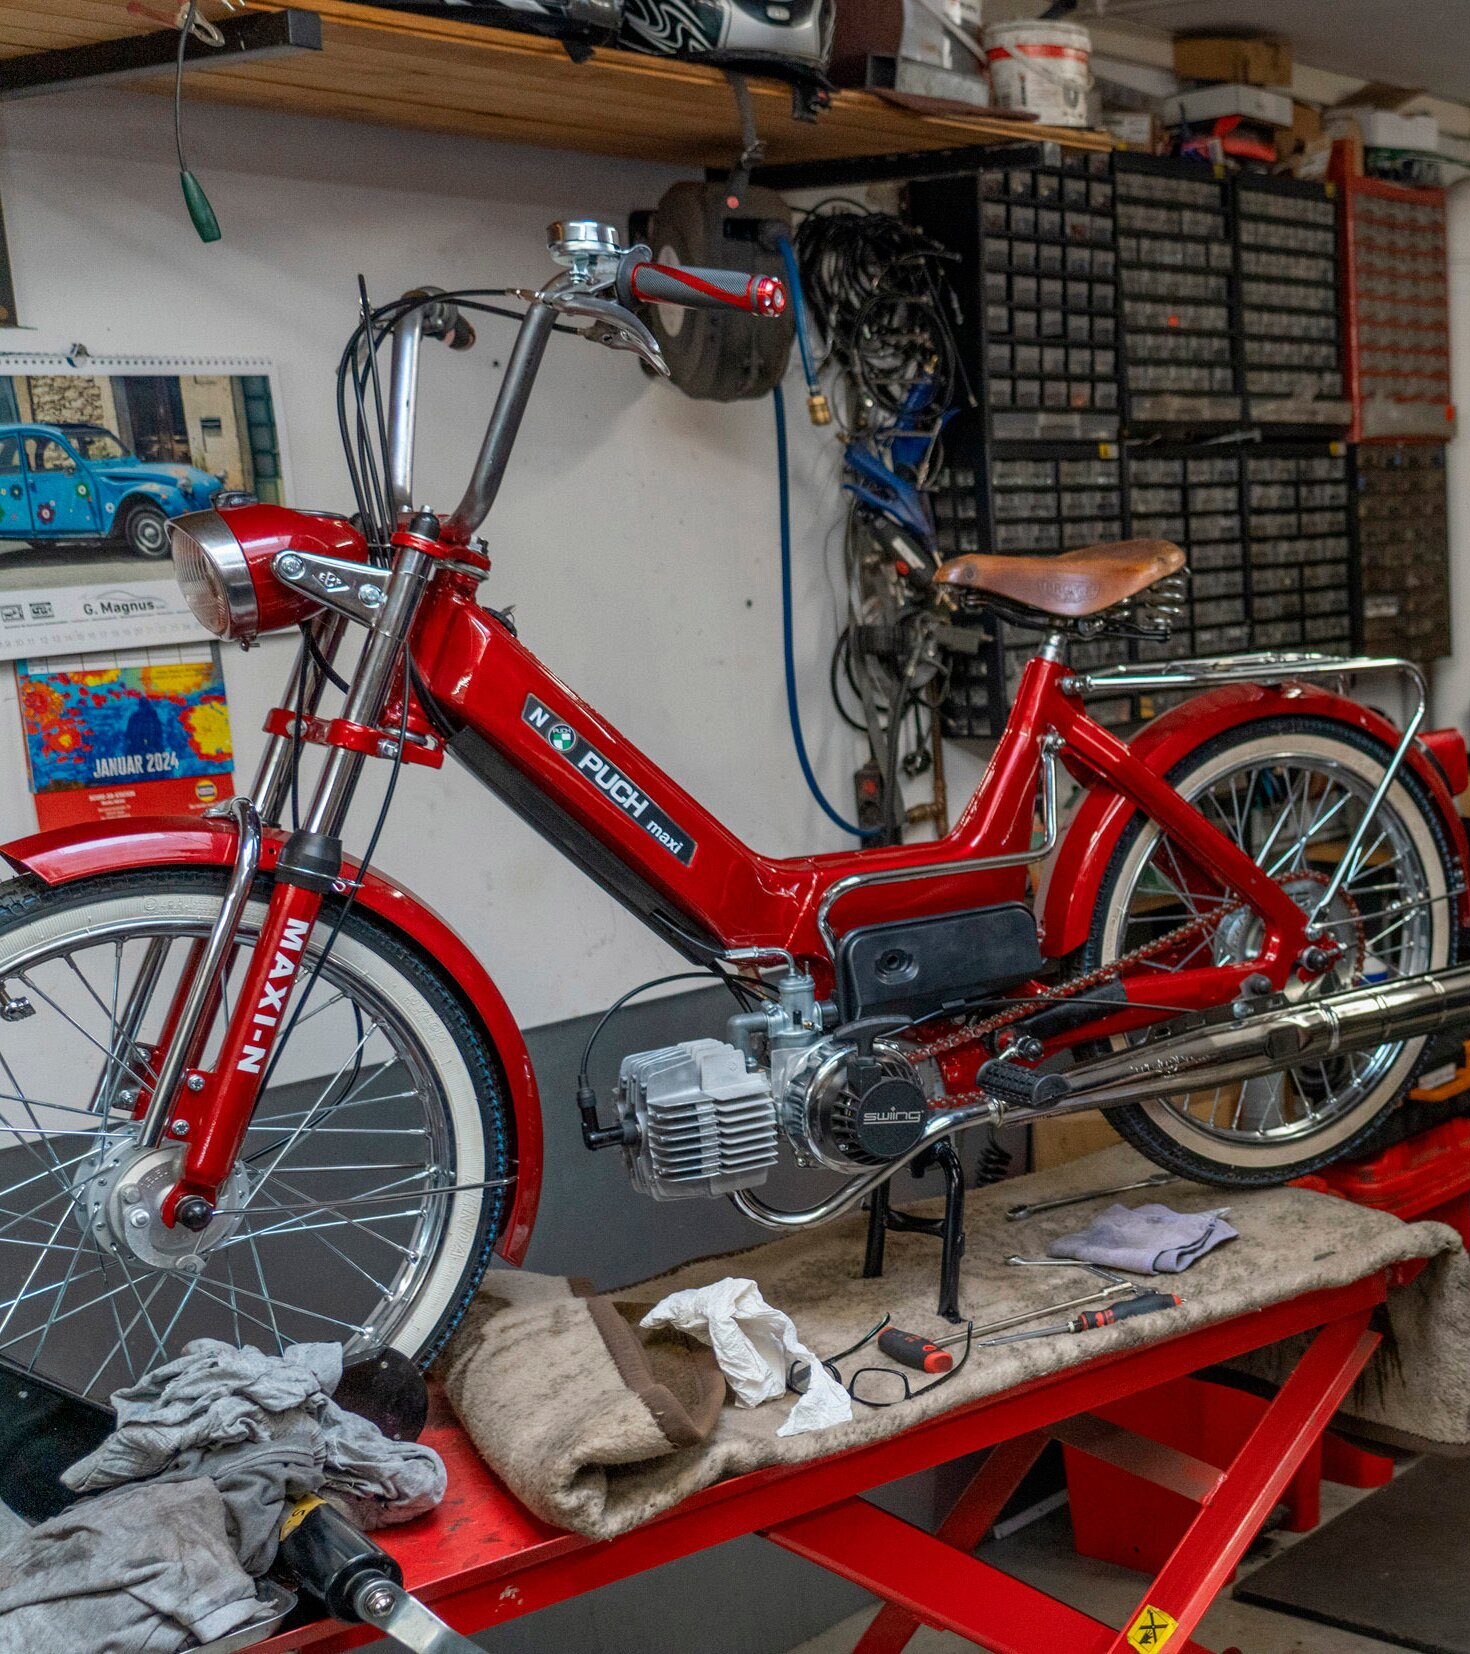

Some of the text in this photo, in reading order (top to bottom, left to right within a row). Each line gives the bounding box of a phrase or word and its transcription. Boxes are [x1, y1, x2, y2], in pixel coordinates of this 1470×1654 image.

[83, 603, 99, 616] G.
[100, 600, 155, 616] Magnus
[528, 707, 550, 728] N
[93, 751, 179, 778] JANUAR 2024
[578, 751, 684, 855] PUCH maxi
[237, 918, 309, 1074] MAXI-N
